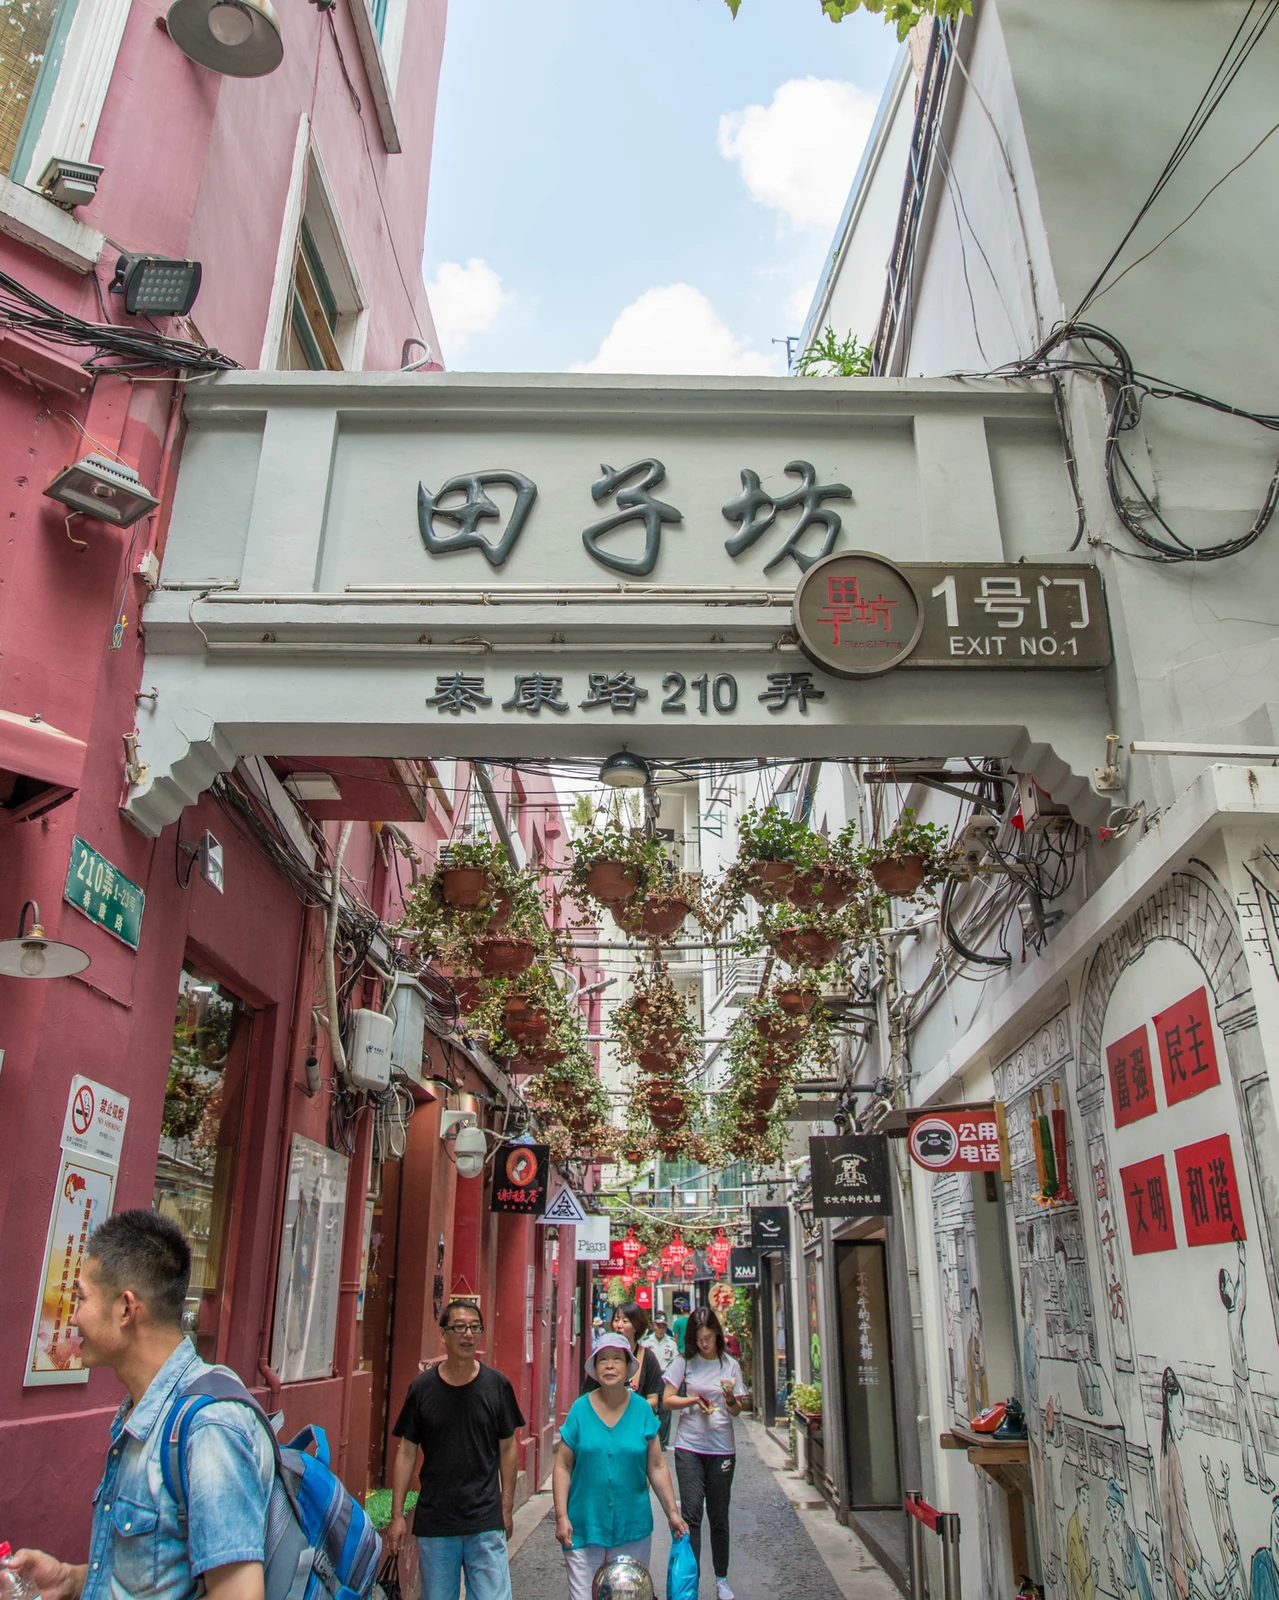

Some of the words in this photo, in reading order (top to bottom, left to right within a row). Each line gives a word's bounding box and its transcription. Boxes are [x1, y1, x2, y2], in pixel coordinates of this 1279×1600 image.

[418, 458, 853, 573] 田子坊
[931, 575, 1091, 629] 1号门
[949, 636, 1007, 655] EXIT
[1020, 636, 1078, 656] NO.1
[425, 669, 826, 713] 泰康路210弄
[83, 890, 123, 932] 泰康路
[1164, 1014, 1210, 1086] 民主
[1114, 1046, 1150, 1112] 富强
[99, 1098, 125, 1122] 禁止吸烟
[958, 1122, 998, 1142] 公用
[959, 1144, 1000, 1163] 电话
[1130, 1176, 1169, 1237] 文明
[1185, 1157, 1234, 1227] 和谐
[577, 1240, 608, 1252] Piara
[1092, 1159, 1126, 1325] 田子坊
